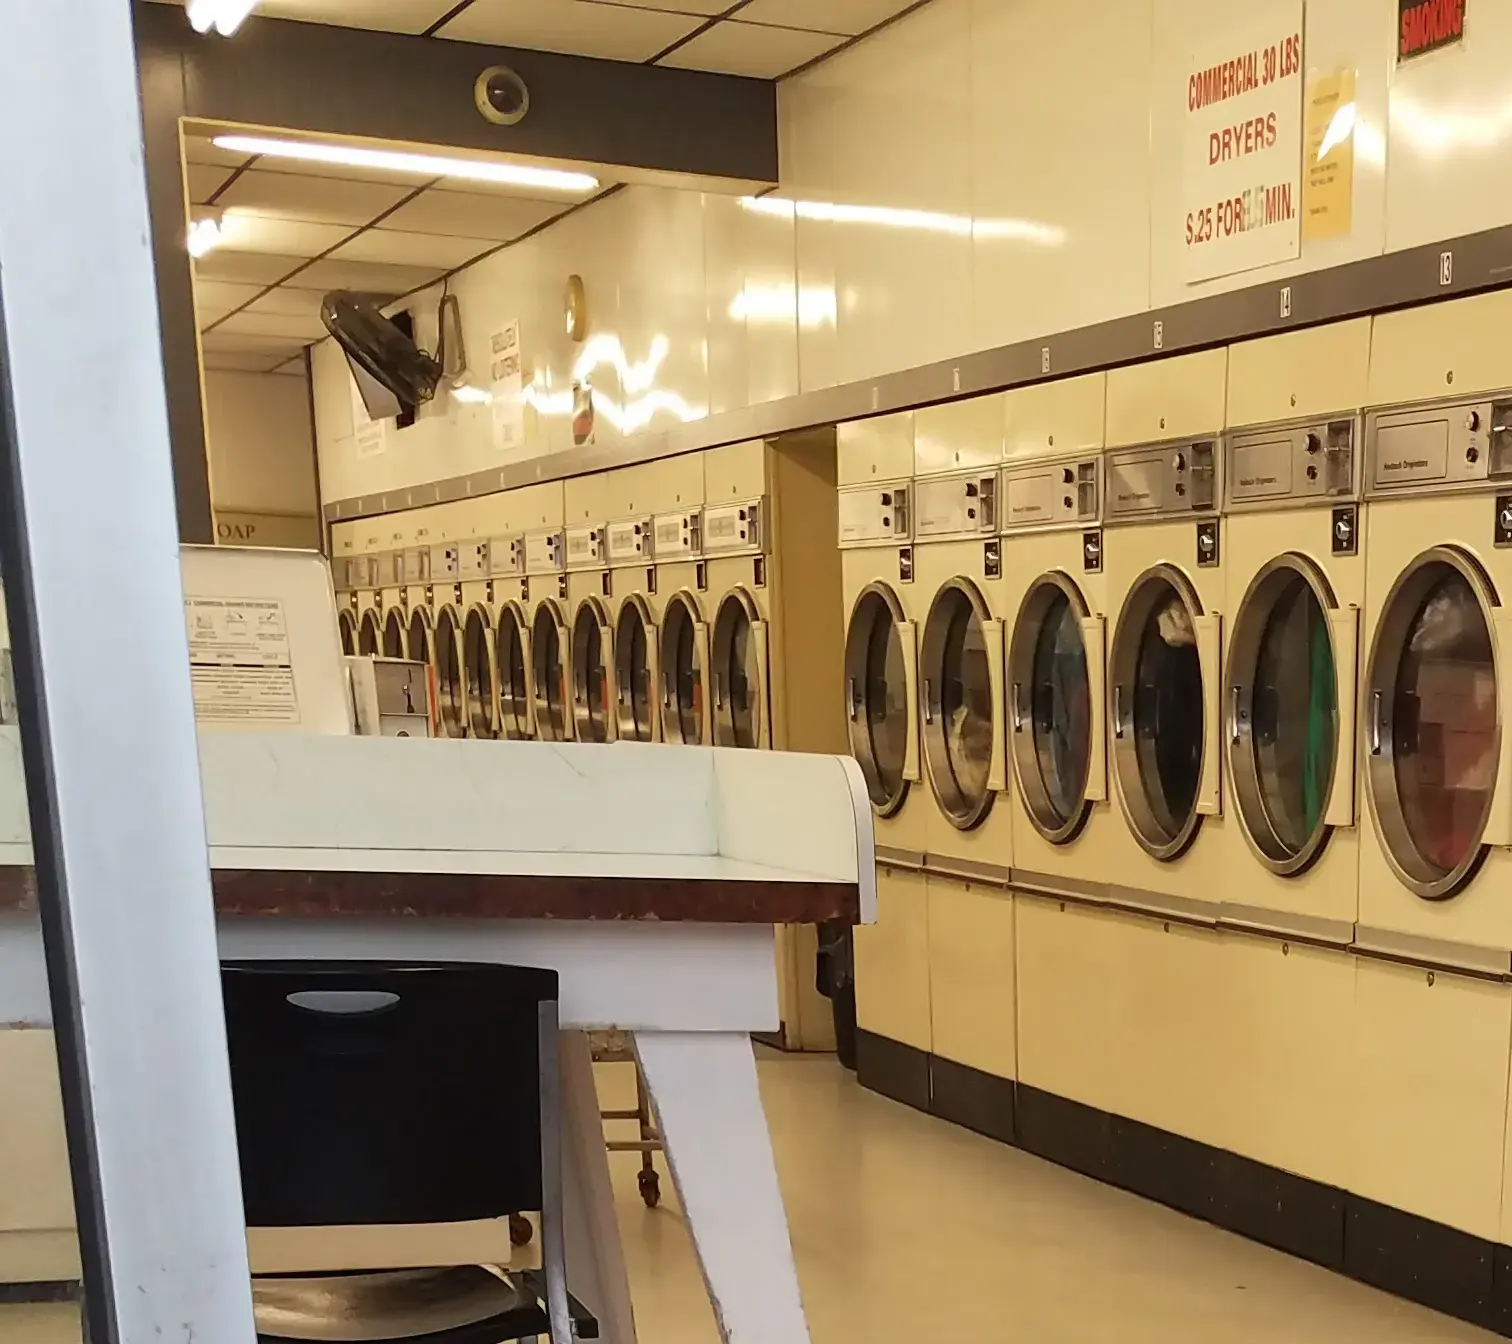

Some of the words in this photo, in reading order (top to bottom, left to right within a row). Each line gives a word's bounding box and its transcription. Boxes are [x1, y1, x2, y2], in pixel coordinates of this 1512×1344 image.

[1188, 51, 1259, 112] COMMERCIAL
[1262, 45, 1276, 86] 30
[1279, 33, 1300, 79] LBS
[1208, 111, 1277, 166] DRYERS
[1216, 197, 1243, 238] FOR
[1265, 182, 1295, 226] MIN.
[1441, 255, 1451, 283] 13
[1281, 288, 1290, 316] 14
